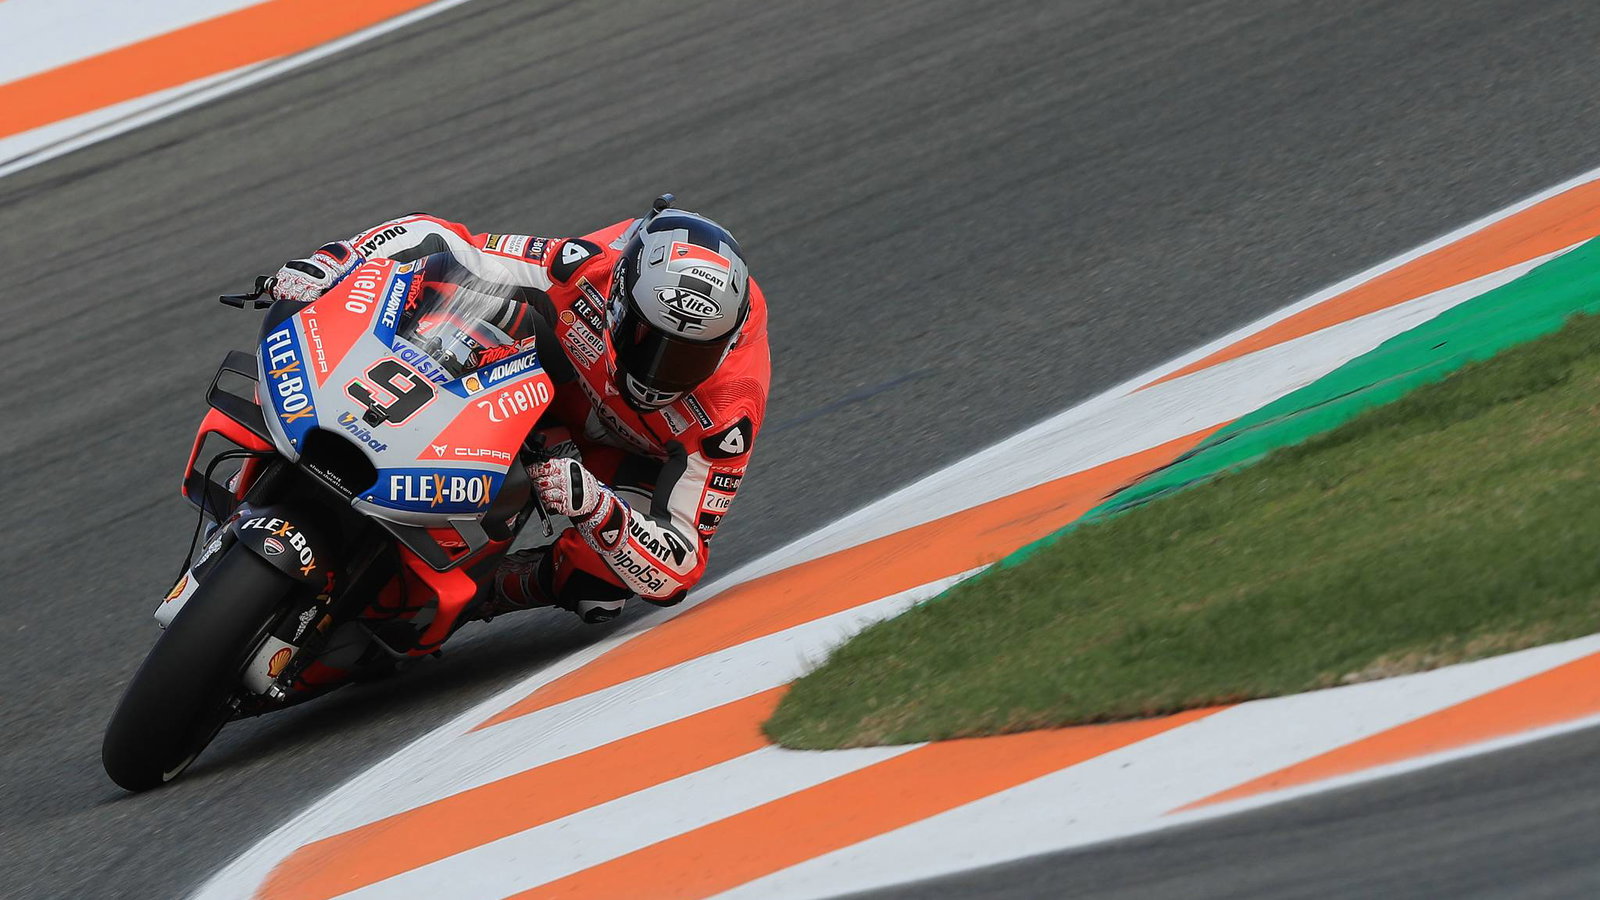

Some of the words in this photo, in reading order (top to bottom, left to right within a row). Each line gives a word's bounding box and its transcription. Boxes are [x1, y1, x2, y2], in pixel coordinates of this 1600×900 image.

[360, 225, 408, 258] DUCAT
[691, 268, 724, 288] DUCATI
[381, 277, 406, 329] ADVANCE
[664, 289, 713, 315] X-lite
[308, 318, 329, 374] CUPRA
[391, 341, 449, 383] valsir
[567, 332, 596, 359] valsir
[266, 328, 316, 424] FLEX-BOX
[488, 352, 537, 383] ADVANCE
[343, 355, 439, 428] 9
[688, 398, 708, 426] MICHELIN
[337, 411, 388, 454] Unibat
[454, 447, 511, 461] CUPRA
[390, 473, 492, 508] FLEX-BOX
[241, 517, 316, 576] FLEX-BOX
[613, 549, 667, 592] nipolSai
